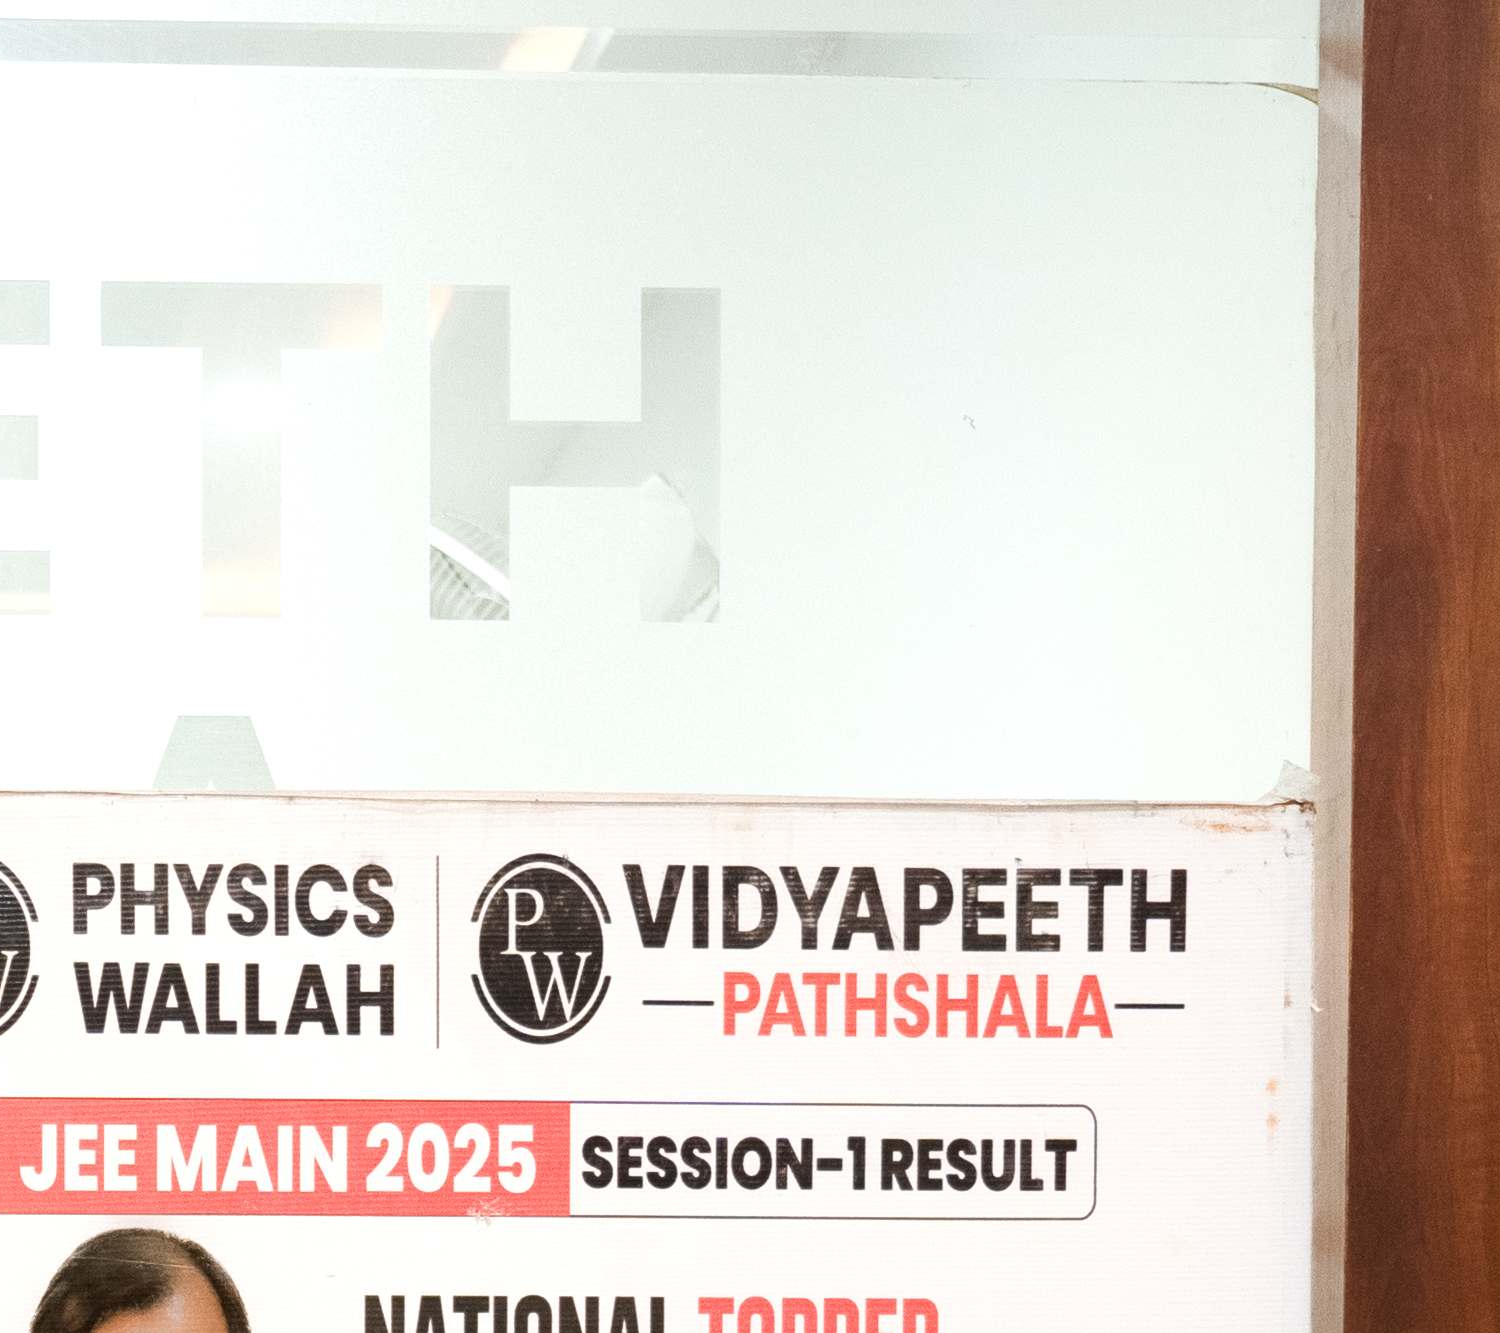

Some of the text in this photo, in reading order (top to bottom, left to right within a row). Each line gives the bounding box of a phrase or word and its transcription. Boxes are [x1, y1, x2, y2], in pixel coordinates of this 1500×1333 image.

[72, 862, 395, 939] PHYSICS
[621, 863, 1188, 953] VIDYAPEETH
[72, 961, 395, 1037] WALLAH
[723, 971, 1114, 1039] PATHSHALA
[19, 1123, 138, 1192] JEE
[156, 1123, 348, 1193] MAIN
[365, 1121, 537, 1194] 2025
[880, 1137, 1078, 1192] RESULT
